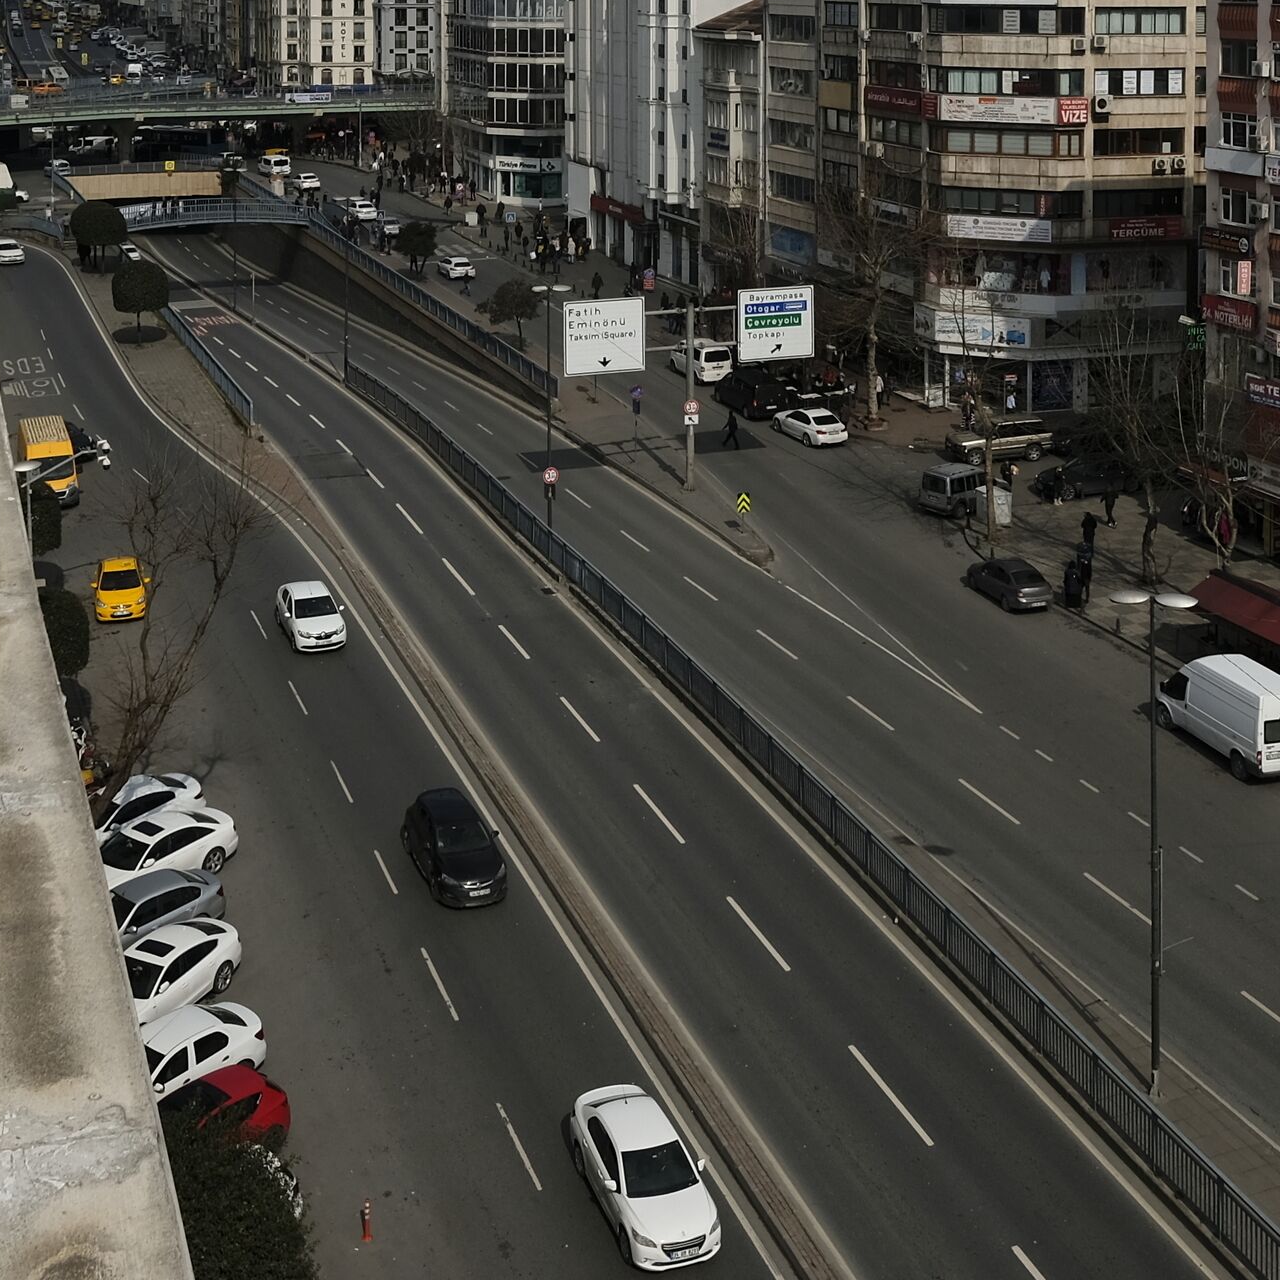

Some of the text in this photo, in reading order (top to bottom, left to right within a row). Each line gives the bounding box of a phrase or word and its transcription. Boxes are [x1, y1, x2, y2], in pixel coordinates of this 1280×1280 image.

[499, 160, 518, 168] Türkiye
[1111, 226, 1165, 238] TERCÜME
[749, 291, 804, 302] Bayrampaşa
[568, 307, 601, 317] Fatih
[746, 304, 780, 314] Otogar
[745, 315, 800, 329] Çevreyolu
[568, 329, 637, 341] Taksim (Square)
[747, 331, 785, 340] Topkapı
